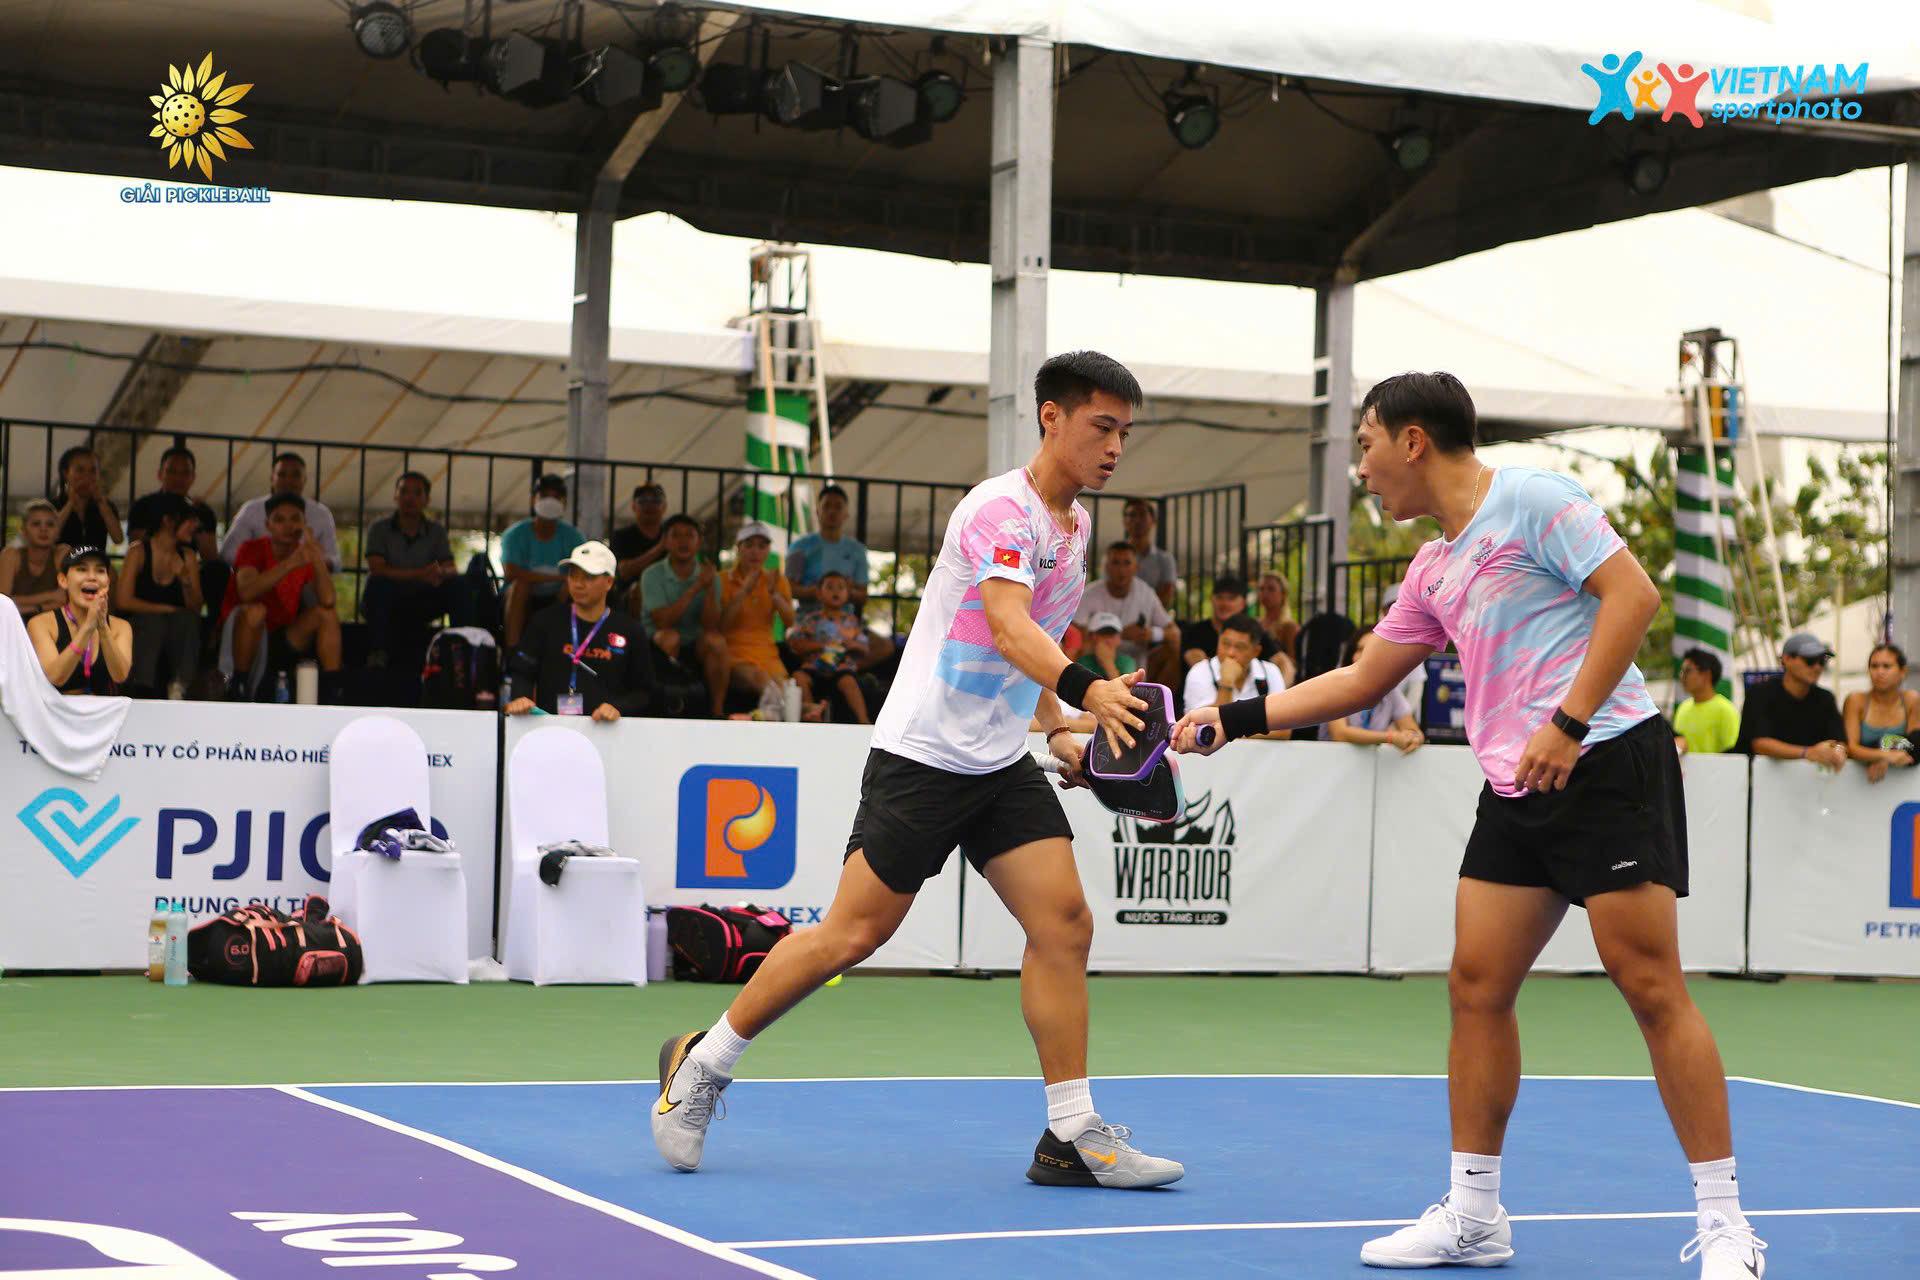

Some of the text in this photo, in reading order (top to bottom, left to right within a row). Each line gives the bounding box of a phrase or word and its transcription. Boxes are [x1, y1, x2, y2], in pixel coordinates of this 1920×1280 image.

[143, 744, 166, 758] TY
[172, 739, 199, 760] CỔ
[205, 741, 257, 762] PHẦN
[260, 745, 298, 763] BẢO
[302, 744, 330, 764] HIỂ
[1117, 806, 1147, 817] TRITON
[1114, 847, 1232, 906] WARRIOR
